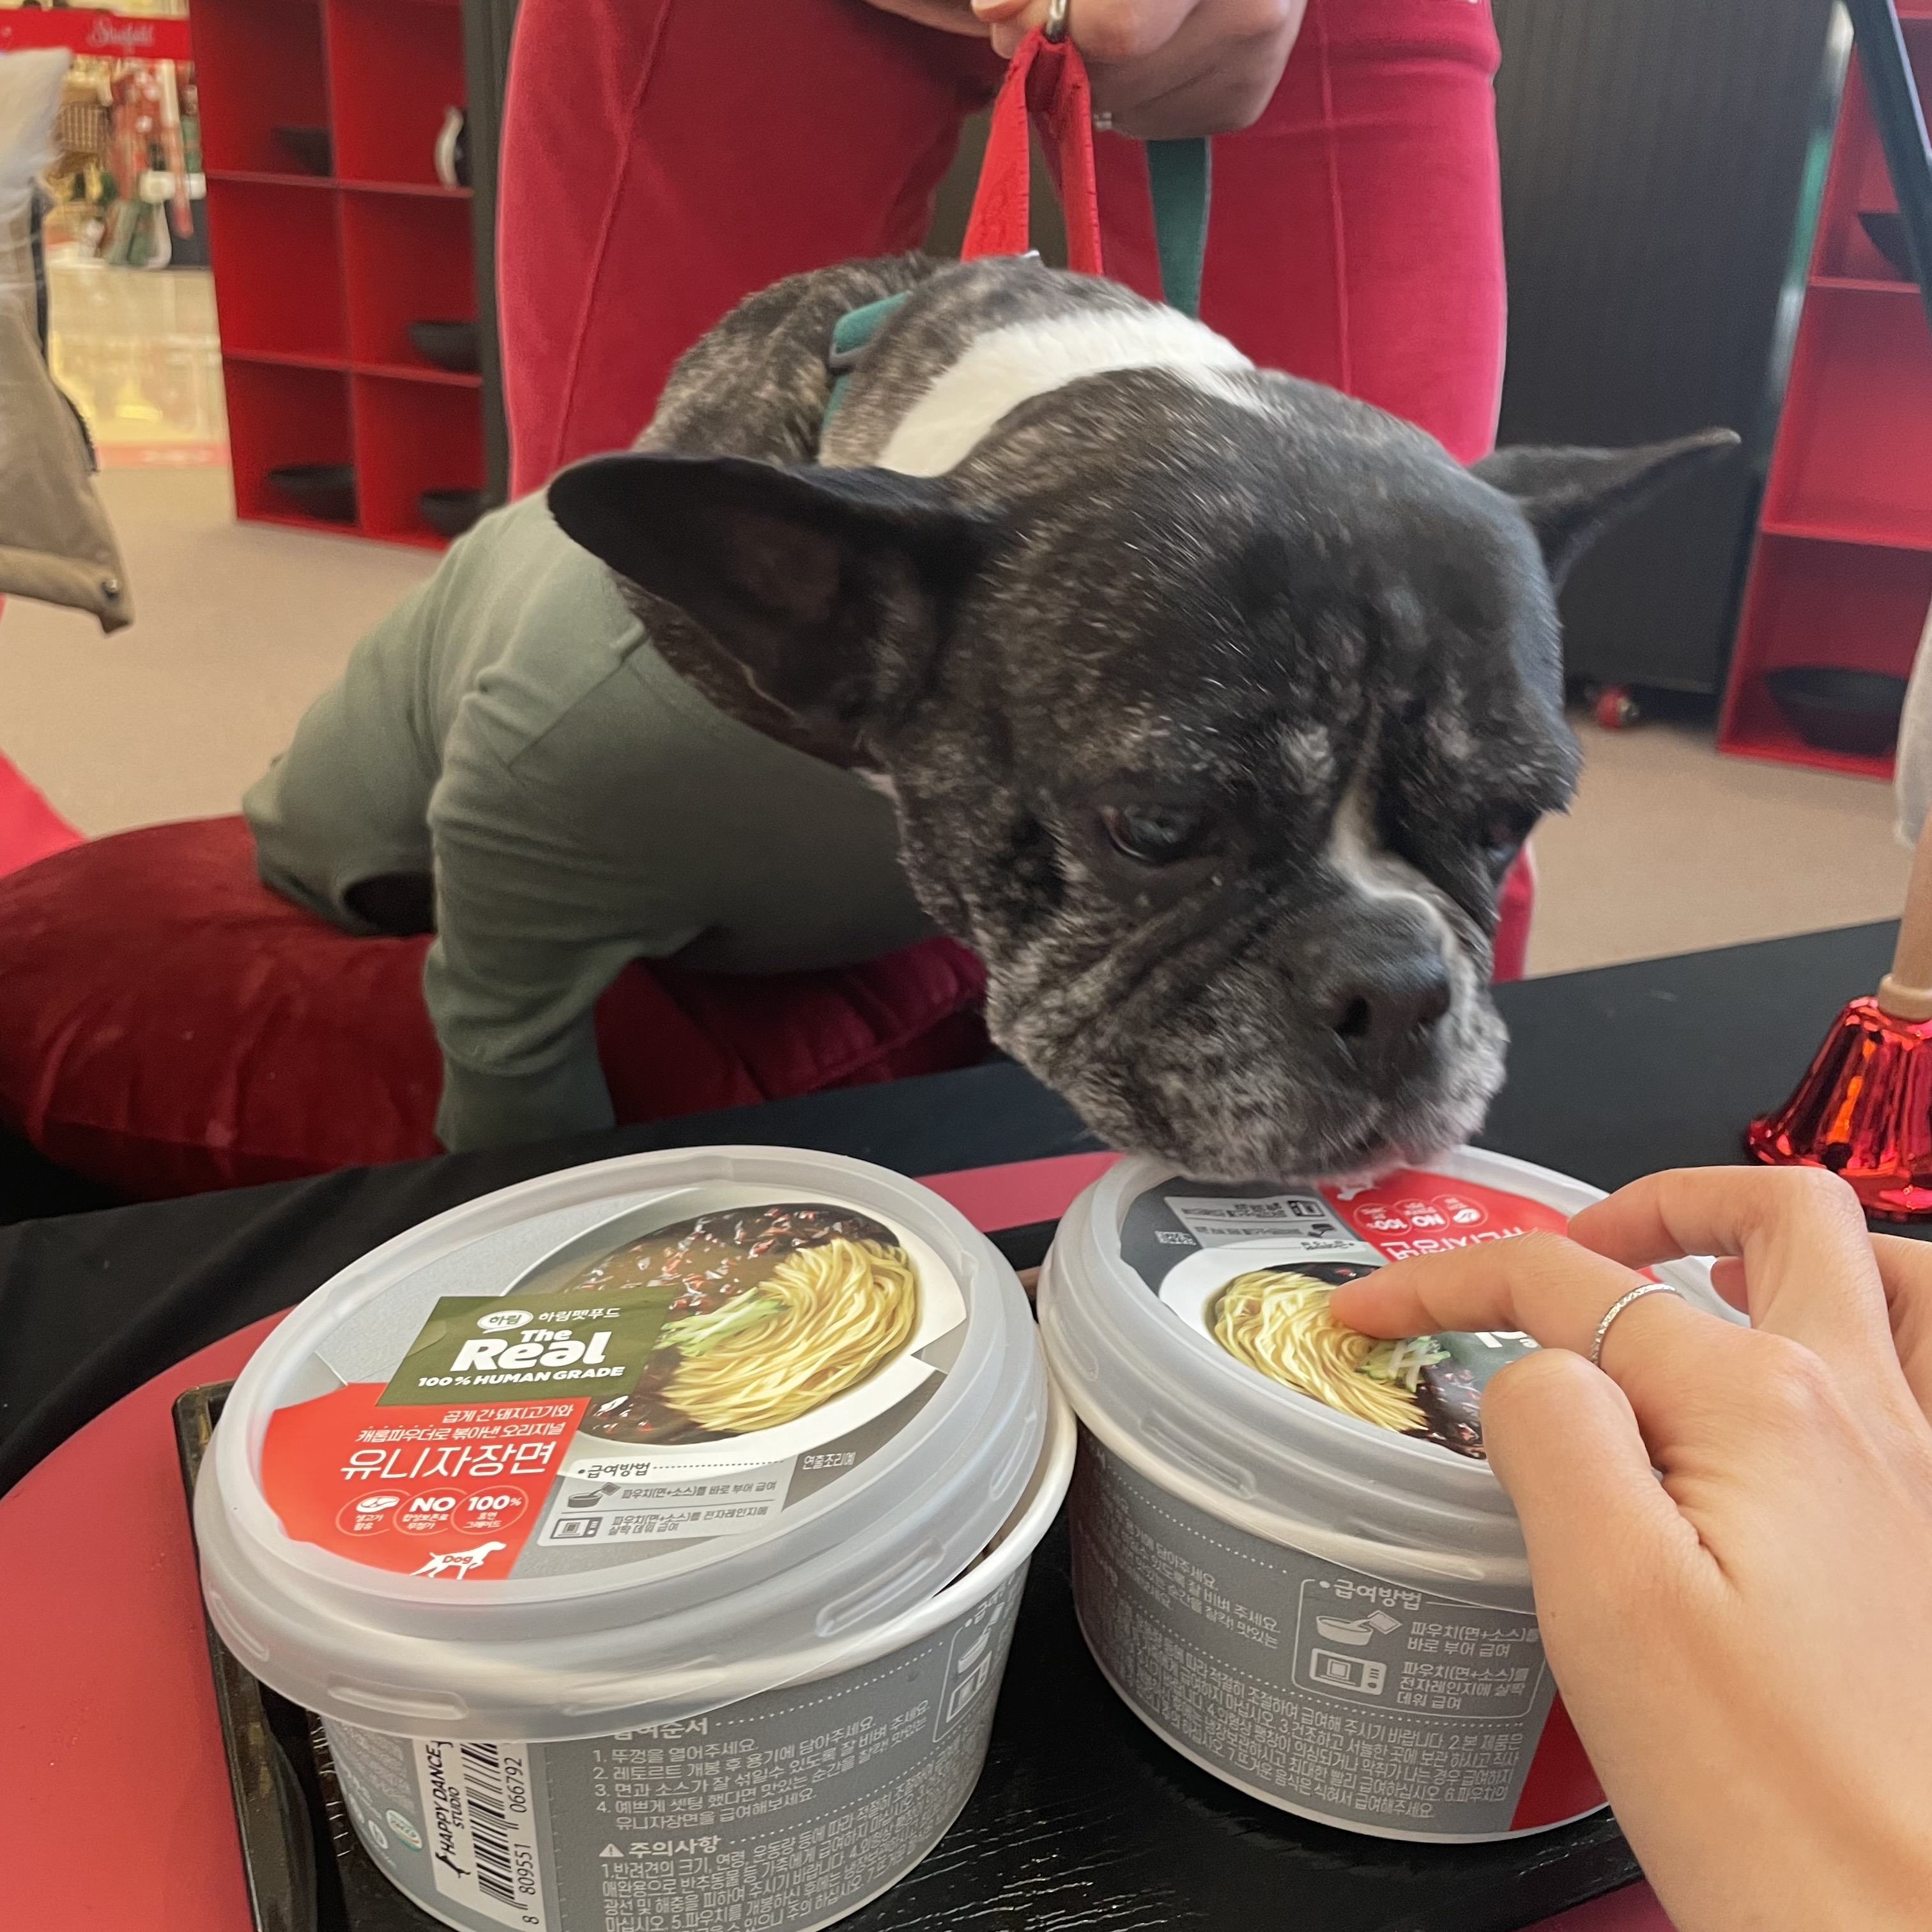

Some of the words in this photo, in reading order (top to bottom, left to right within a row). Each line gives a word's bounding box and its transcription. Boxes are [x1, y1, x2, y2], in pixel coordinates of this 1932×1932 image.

[489, 1314, 523, 1326] 하림
[539, 1308, 621, 1322] 하림펫푸드
[521, 1329, 572, 1343] The
[450, 1331, 612, 1372] Real
[418, 1376, 471, 1387] 100%
[473, 1370, 552, 1386] HUMAN
[553, 1366, 625, 1380] GRADE
[442, 1409, 477, 1423] 곱게
[477, 1409, 494, 1422] 간
[494, 1404, 575, 1421] 돼지고기와
[452, 1425, 502, 1441] 볶아낸
[503, 1422, 567, 1437] 오리지널
[340, 1441, 557, 1480] 유니자장면
[588, 1462, 651, 1478] 급여방법
[709, 1485, 731, 1496] 바로
[755, 1480, 777, 1492] 급여
[409, 1497, 456, 1512] NO
[467, 1495, 522, 1512] 100%
[657, 1522, 679, 1533] 급여
[442, 1556, 474, 1564] Dog
[1334, 1579, 1422, 1611] 급여방법
[1407, 1637, 1439, 1653] 바로
[1444, 1640, 1475, 1655] 부어
[1479, 1643, 1510, 1658] 급여
[1400, 1676, 1492, 1696] 전자레인지에
[1494, 1682, 1526, 1697] 살짝
[1397, 1691, 1427, 1707] 데워
[1431, 1695, 1462, 1710] 급여
[593, 1767, 608, 1779] 2.
[613, 1765, 682, 1780] 레토르트
[687, 1760, 721, 1777] 개봉
[725, 1758, 742, 1771] 후
[746, 1744, 795, 1768] 용기에
[594, 1784, 610, 1797] 3.
[615, 1783, 649, 1798] 면과
[655, 1779, 709, 1796] 소스가
[712, 1775, 732, 1791] 잘
[789, 1746, 836, 1775] 있도록
[841, 1740, 857, 1757] 잘
[859, 1724, 887, 1748] 비벼
[611, 1749, 664, 1764] 뚜껑을
[425, 1744, 448, 1802] DANCE
[1404, 1767, 1432, 1784] 나는
[503, 1757, 527, 1813] 066792
[596, 1801, 611, 1813] 4.
[615, 1799, 666, 1814] 예쁘게
[670, 1796, 703, 1812] 셋팅
[708, 1788, 756, 1809] 했다면
[761, 1775, 808, 1798] 맛있는
[812, 1755, 855, 1783] 순간을
[448, 1786, 464, 1829] STUDIO
[434, 1801, 457, 1856] HAPPY
[616, 1810, 716, 1830] 유니자장면을
[629, 1835, 721, 1859] 주의사항
[753, 1836, 796, 1864] 운동량
[514, 1844, 536, 1896] 809551
[602, 1878, 677, 1898] 애완용으로
[680, 1870, 740, 1894] 반추동물
[744, 1865, 757, 1883] 등
[604, 1898, 634, 1916] 광선
[637, 1897, 652, 1915] 및
[655, 1894, 699, 1913] 해충을
[703, 1885, 746, 1908] 피하여
[749, 1873, 790, 1898] 주시기
[522, 1915, 539, 1924] 8
